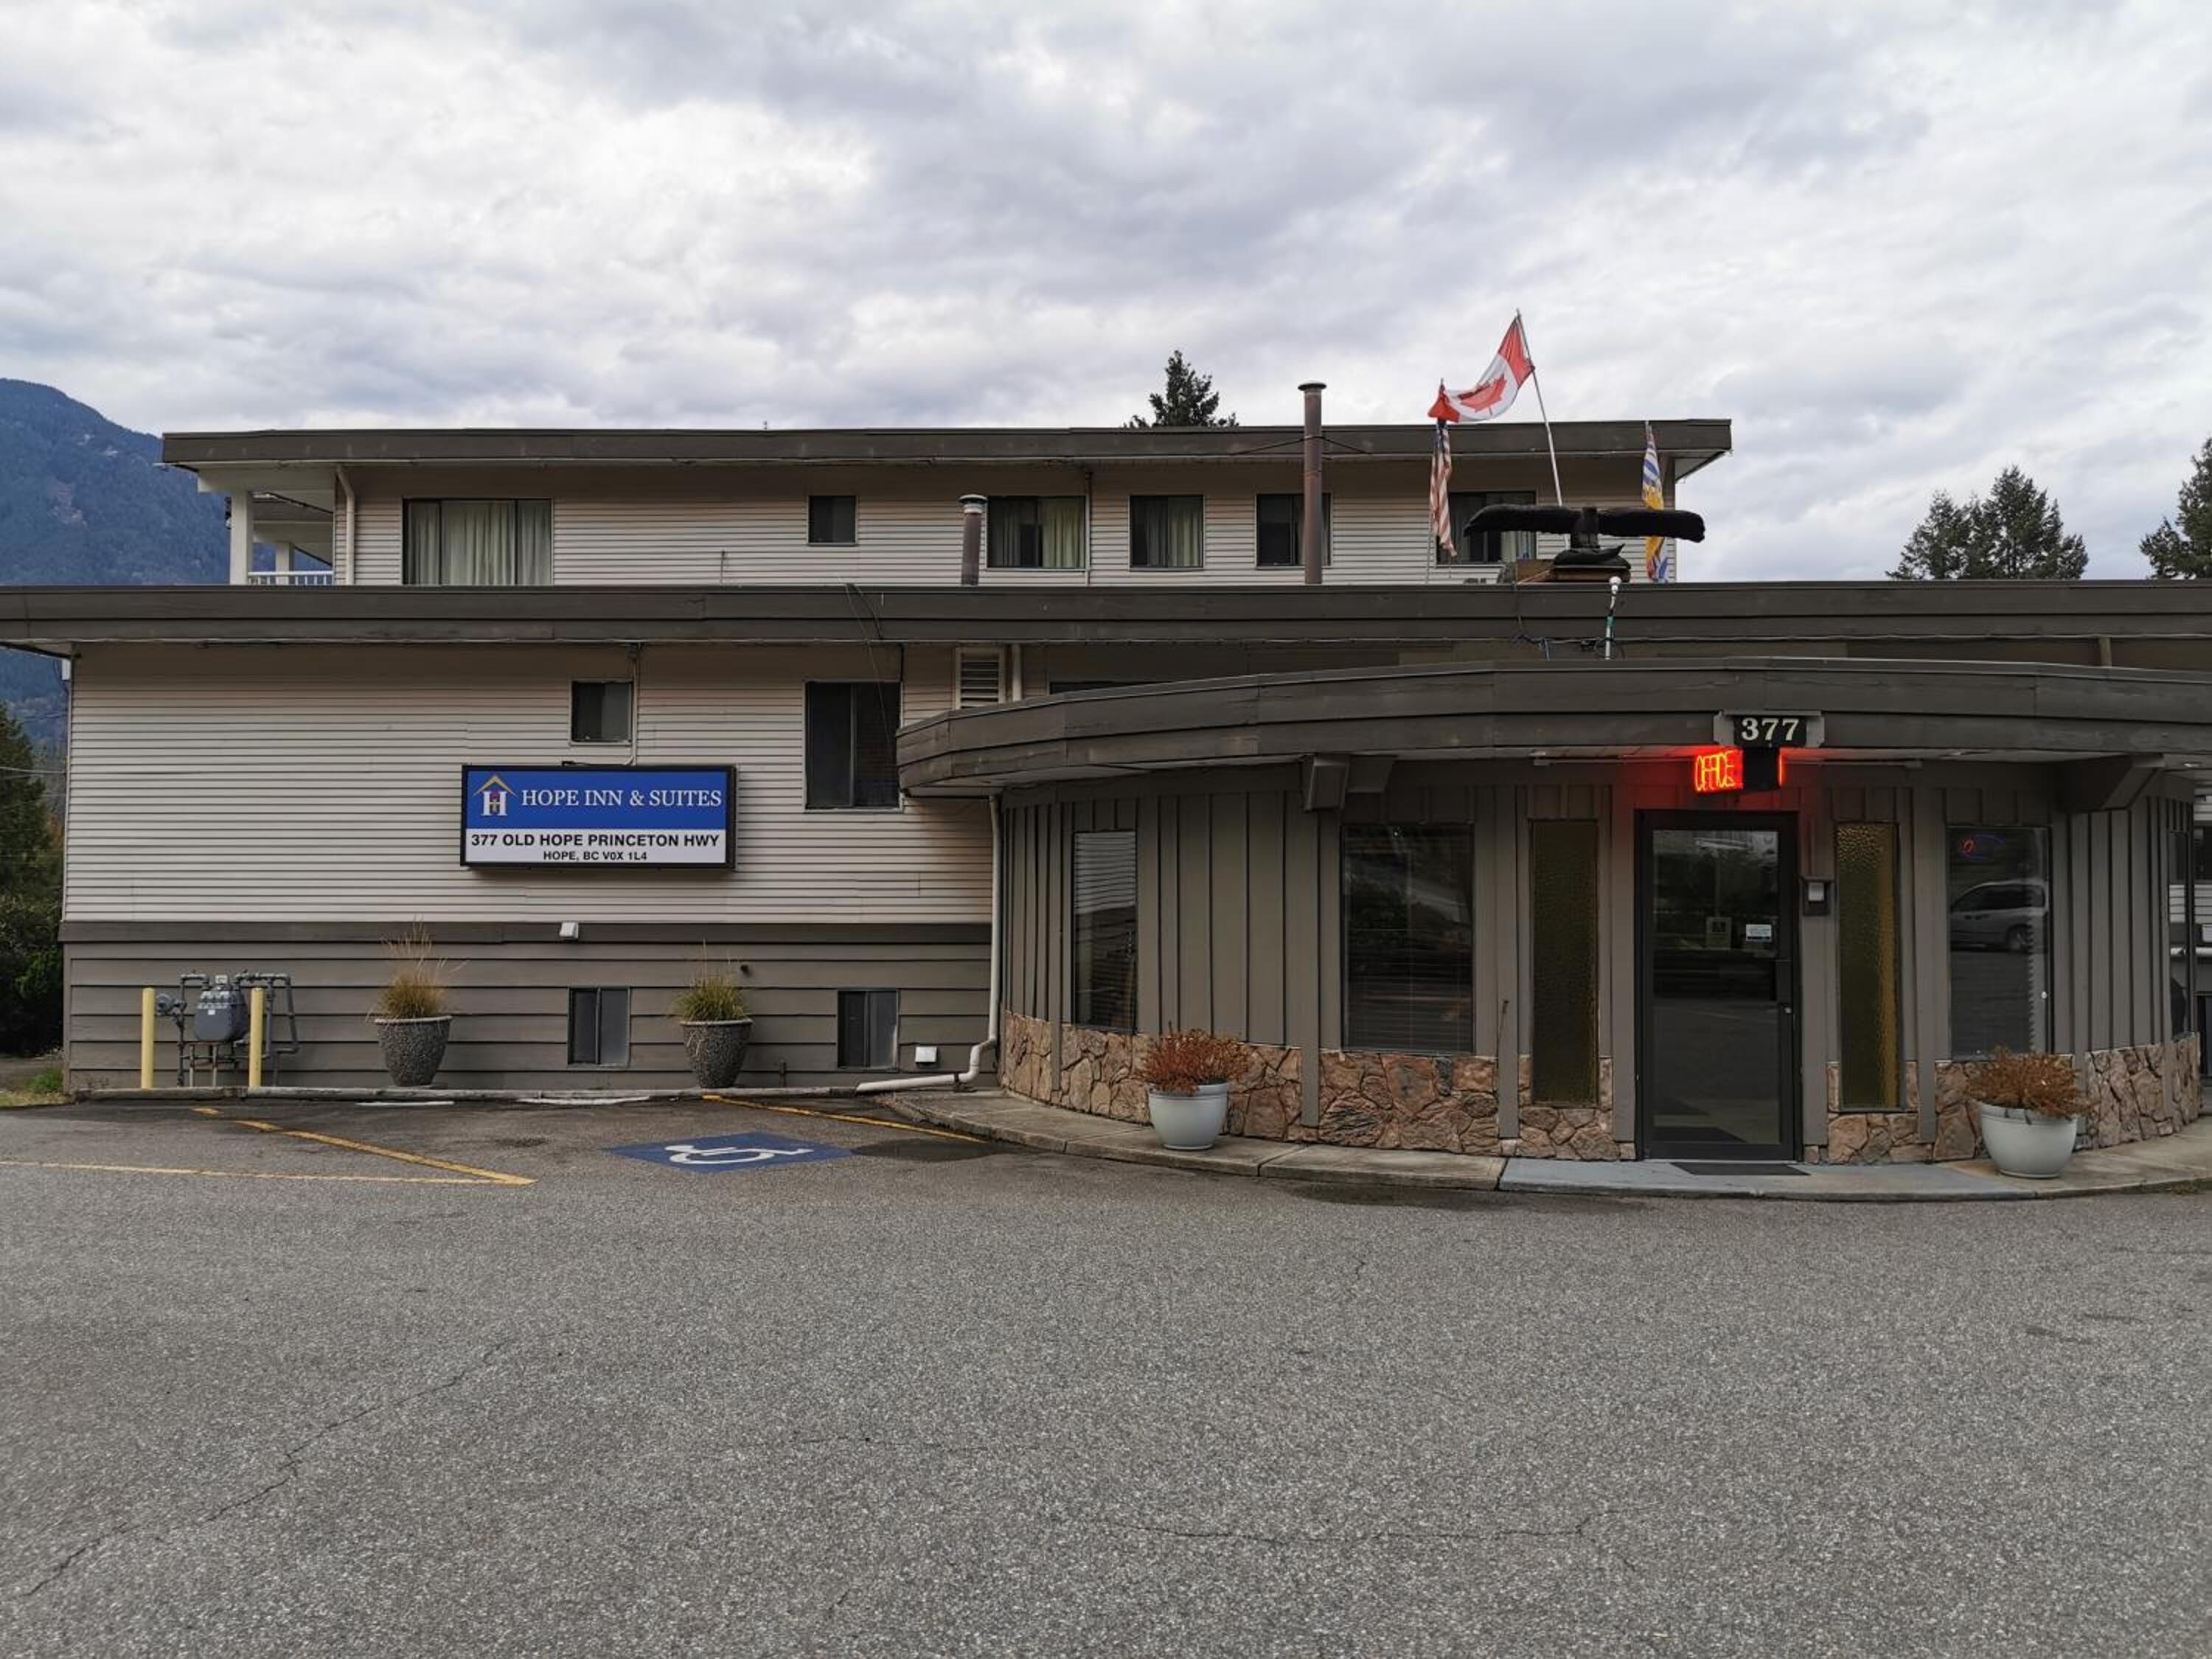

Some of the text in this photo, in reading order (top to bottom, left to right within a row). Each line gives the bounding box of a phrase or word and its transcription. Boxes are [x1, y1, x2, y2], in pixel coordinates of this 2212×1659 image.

[1741, 717, 1799, 741] 377
[521, 790, 722, 806] HOPE INN & SUITES
[471, 834, 720, 846] 377 OLD HOPE PRINCETON HWY
[543, 851, 580, 861] HOPE,
[583, 851, 599, 860] BC
[628, 852, 647, 860] 1L4
